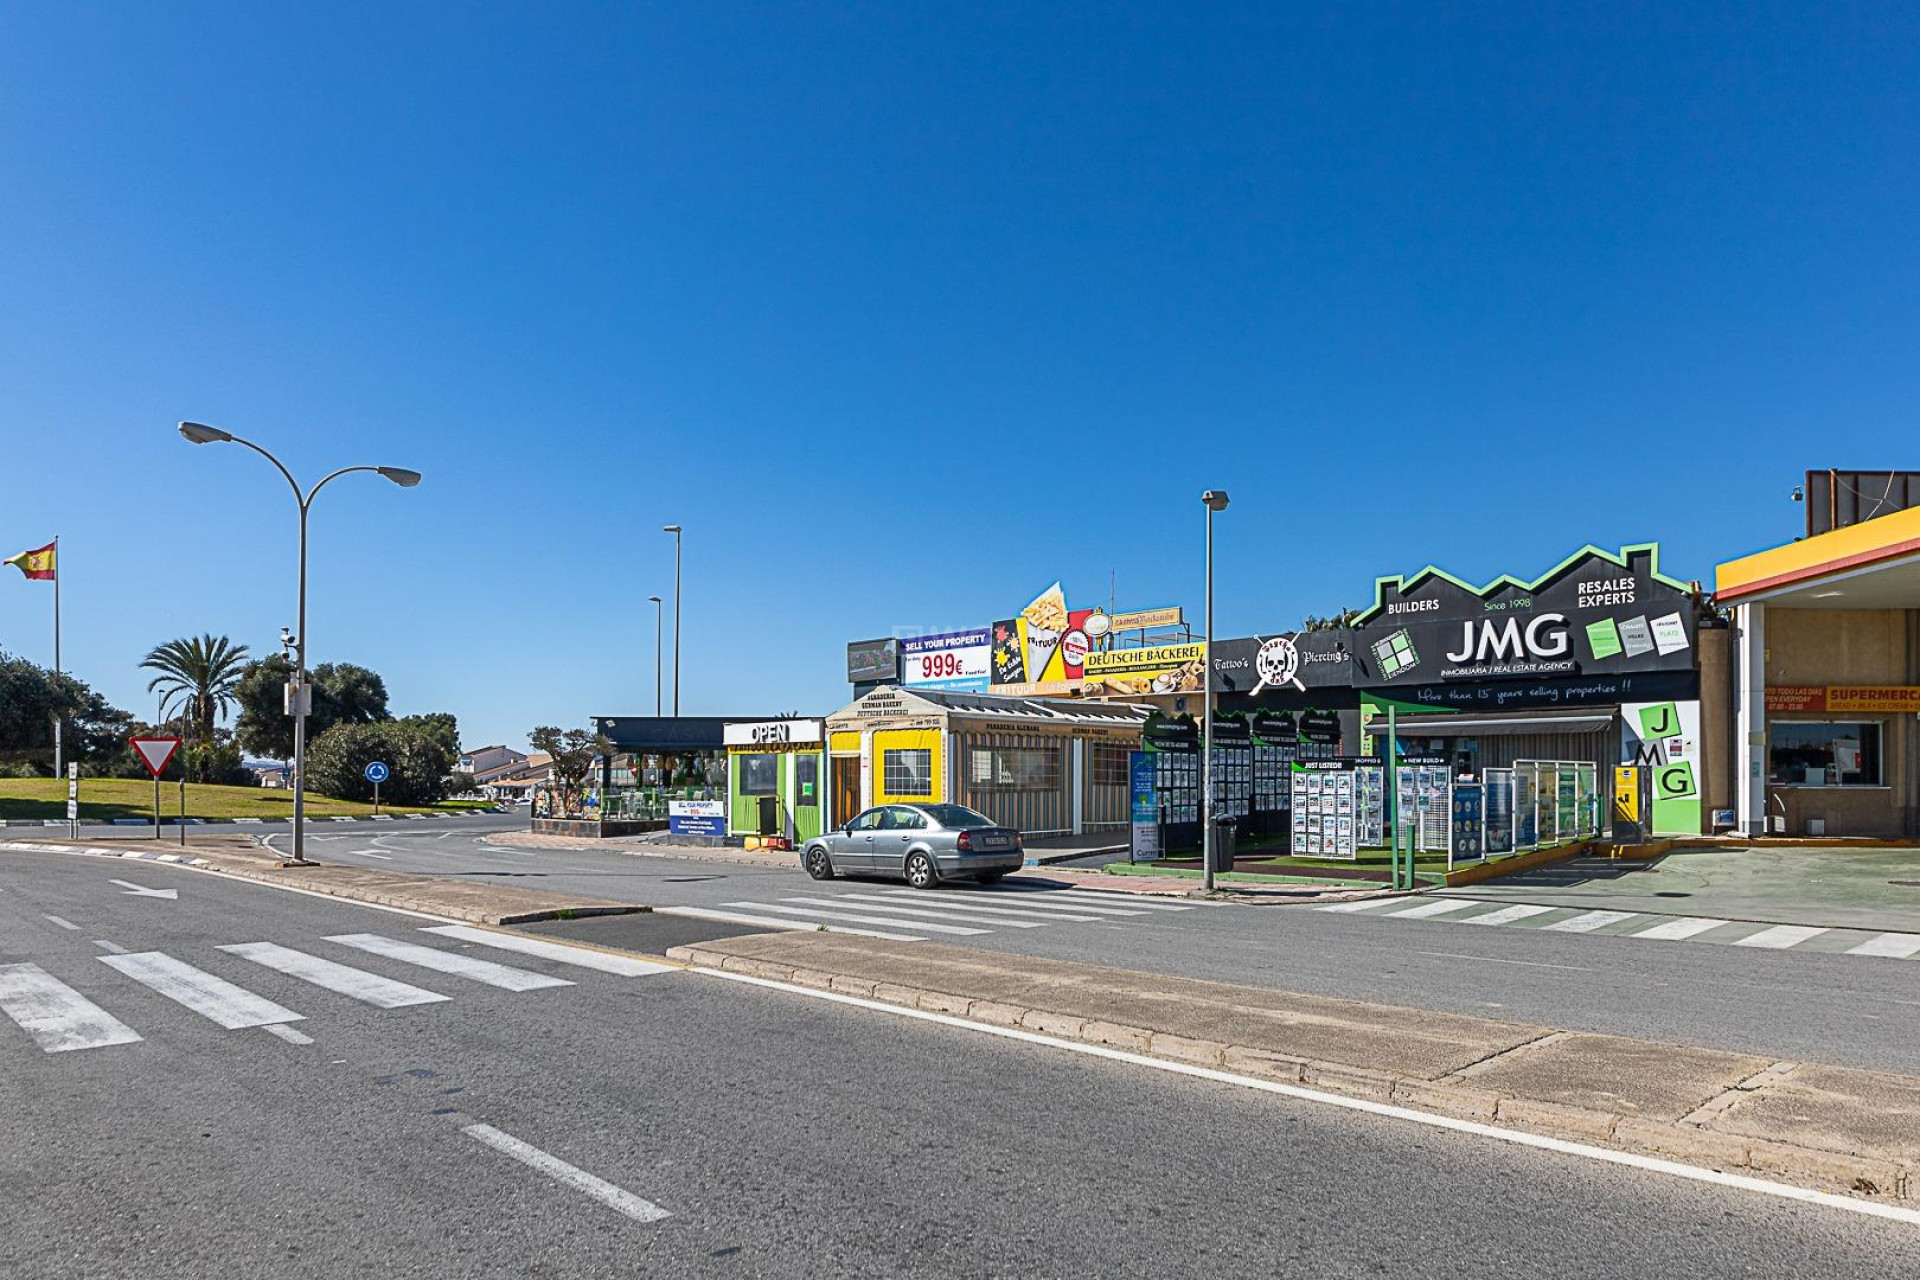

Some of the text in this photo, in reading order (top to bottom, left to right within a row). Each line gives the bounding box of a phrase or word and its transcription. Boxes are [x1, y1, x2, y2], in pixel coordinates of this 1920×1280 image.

[1578, 577, 1635, 595] RESALES
[1388, 599, 1440, 615] BUILDERS
[1484, 599, 1531, 611] Since 1998
[1578, 591, 1635, 608] EXPERTS
[905, 634, 986, 651] SELL YOUR PROPERTY
[1027, 637, 1058, 648] FRITUUR
[1446, 613, 1568, 663] JMG
[922, 653, 963, 678] 999€
[1089, 651, 1144, 666] DEUTSCHE
[1146, 646, 1200, 661] BÄCKEREI
[1493, 665, 1512, 673] REAL
[1512, 664, 1537, 672] ESTATE
[1537, 662, 1573, 671] AGENCY
[1418, 688, 1442, 701] More
[1450, 689, 1472, 701] than
[1497, 689, 1522, 704] years
[1529, 685, 1559, 701] selling
[1565, 683, 1616, 700] properties
[1651, 708, 1669, 733] J
[752, 723, 789, 743] OPEN
[1634, 743, 1662, 767] M
[1661, 768, 1688, 794] G
